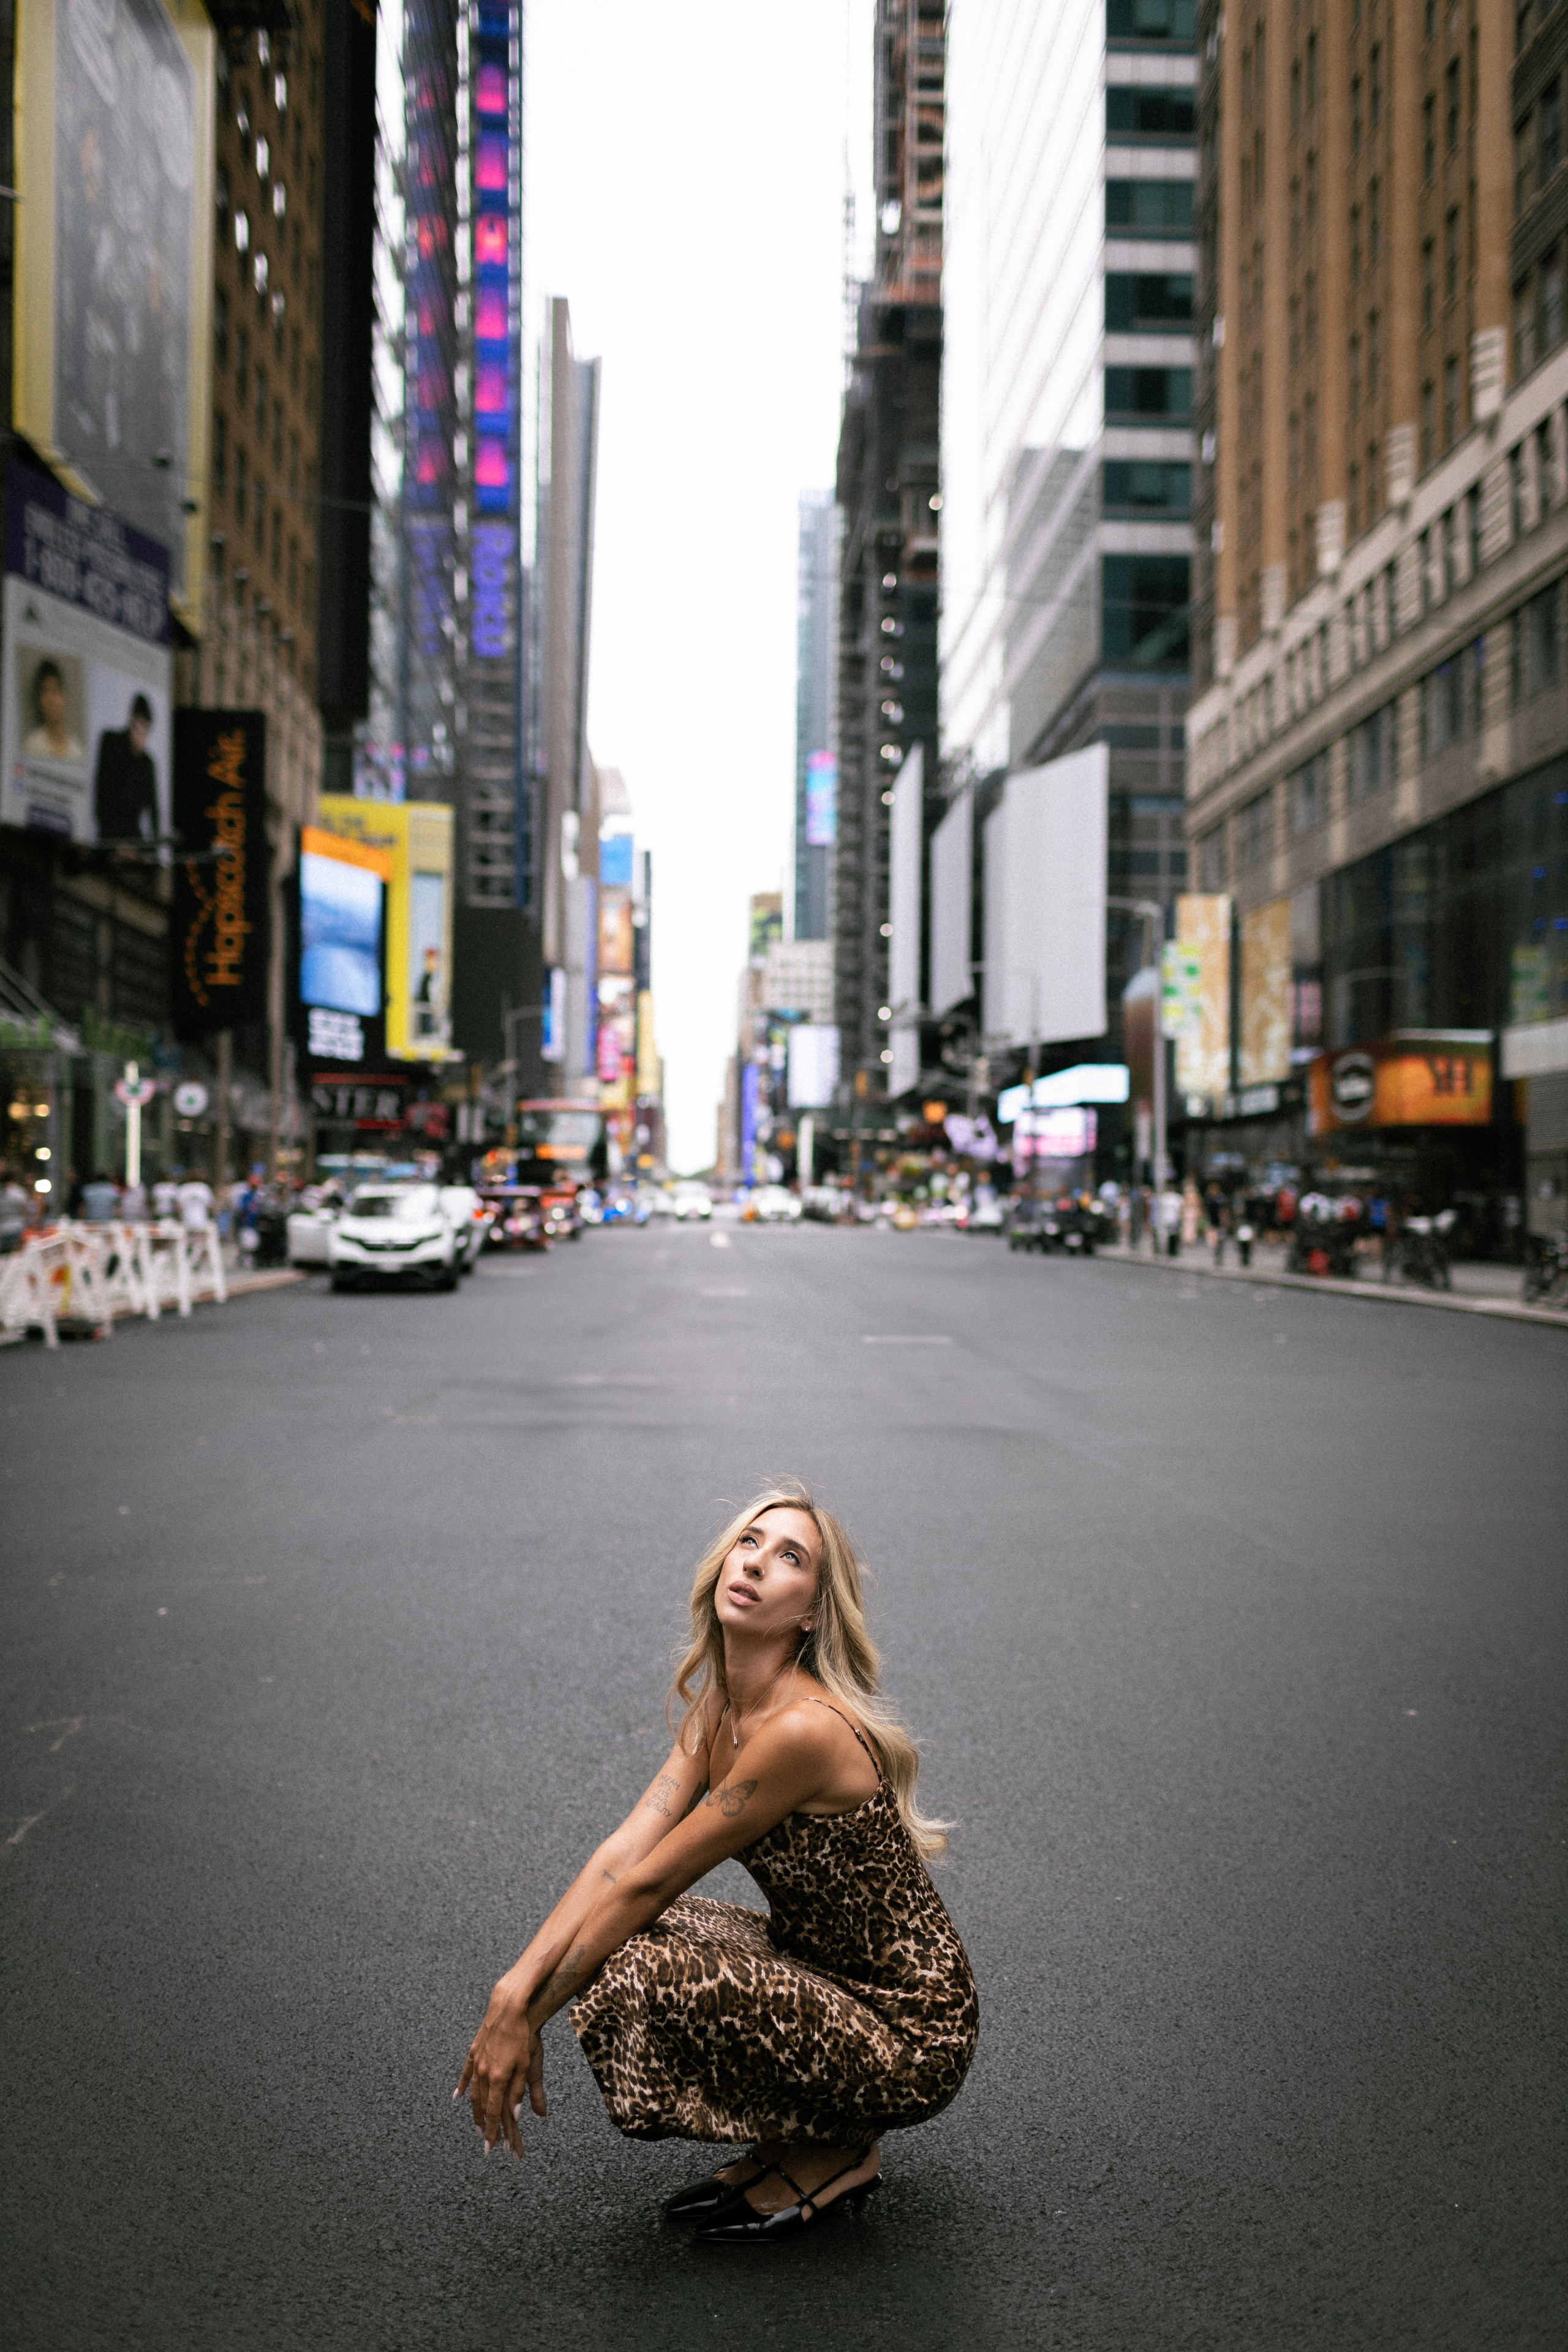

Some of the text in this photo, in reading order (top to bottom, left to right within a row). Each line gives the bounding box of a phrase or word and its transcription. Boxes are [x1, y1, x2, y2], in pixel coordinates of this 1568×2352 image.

[657, 1781, 673, 1795] UNTIL
[659, 1774, 680, 1790] DREAM
[650, 1792, 668, 1807] YOUR
[643, 1798, 673, 1817] REALITY
